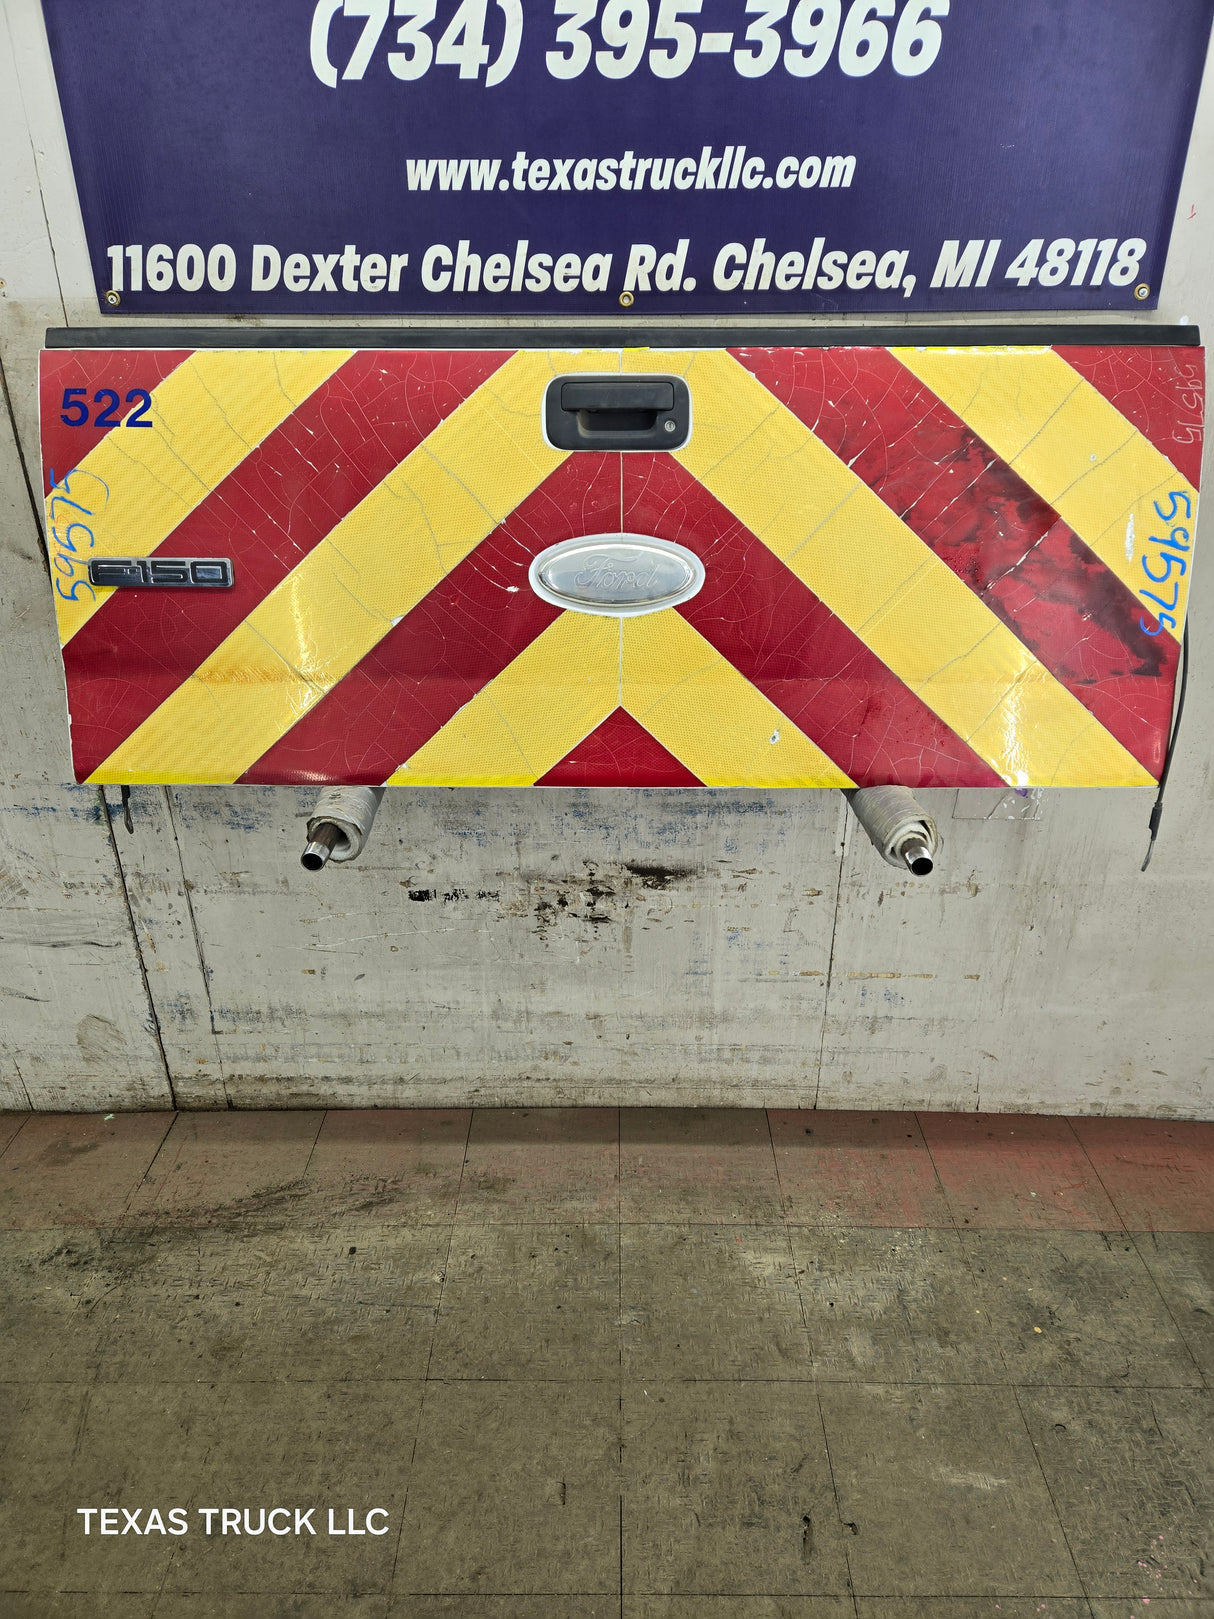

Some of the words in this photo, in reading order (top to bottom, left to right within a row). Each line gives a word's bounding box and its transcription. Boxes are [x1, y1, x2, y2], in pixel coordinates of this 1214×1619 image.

[310, 0, 523, 88] (734)
[546, 0, 951, 79] 395-3966
[406, 146, 856, 191] www.texastruckllc.com
[107, 244, 236, 291] 11600
[252, 245, 408, 292] Dexter
[421, 240, 613, 292] Chelsea
[623, 239, 697, 291] Rd.
[713, 238, 916, 297] Chelsea,
[930, 240, 1001, 287] MI
[1005, 238, 1147, 287] 48118
[60, 388, 153, 428] 522
[574, 551, 658, 590] Ford
[1138, 490, 1191, 636] 59575
